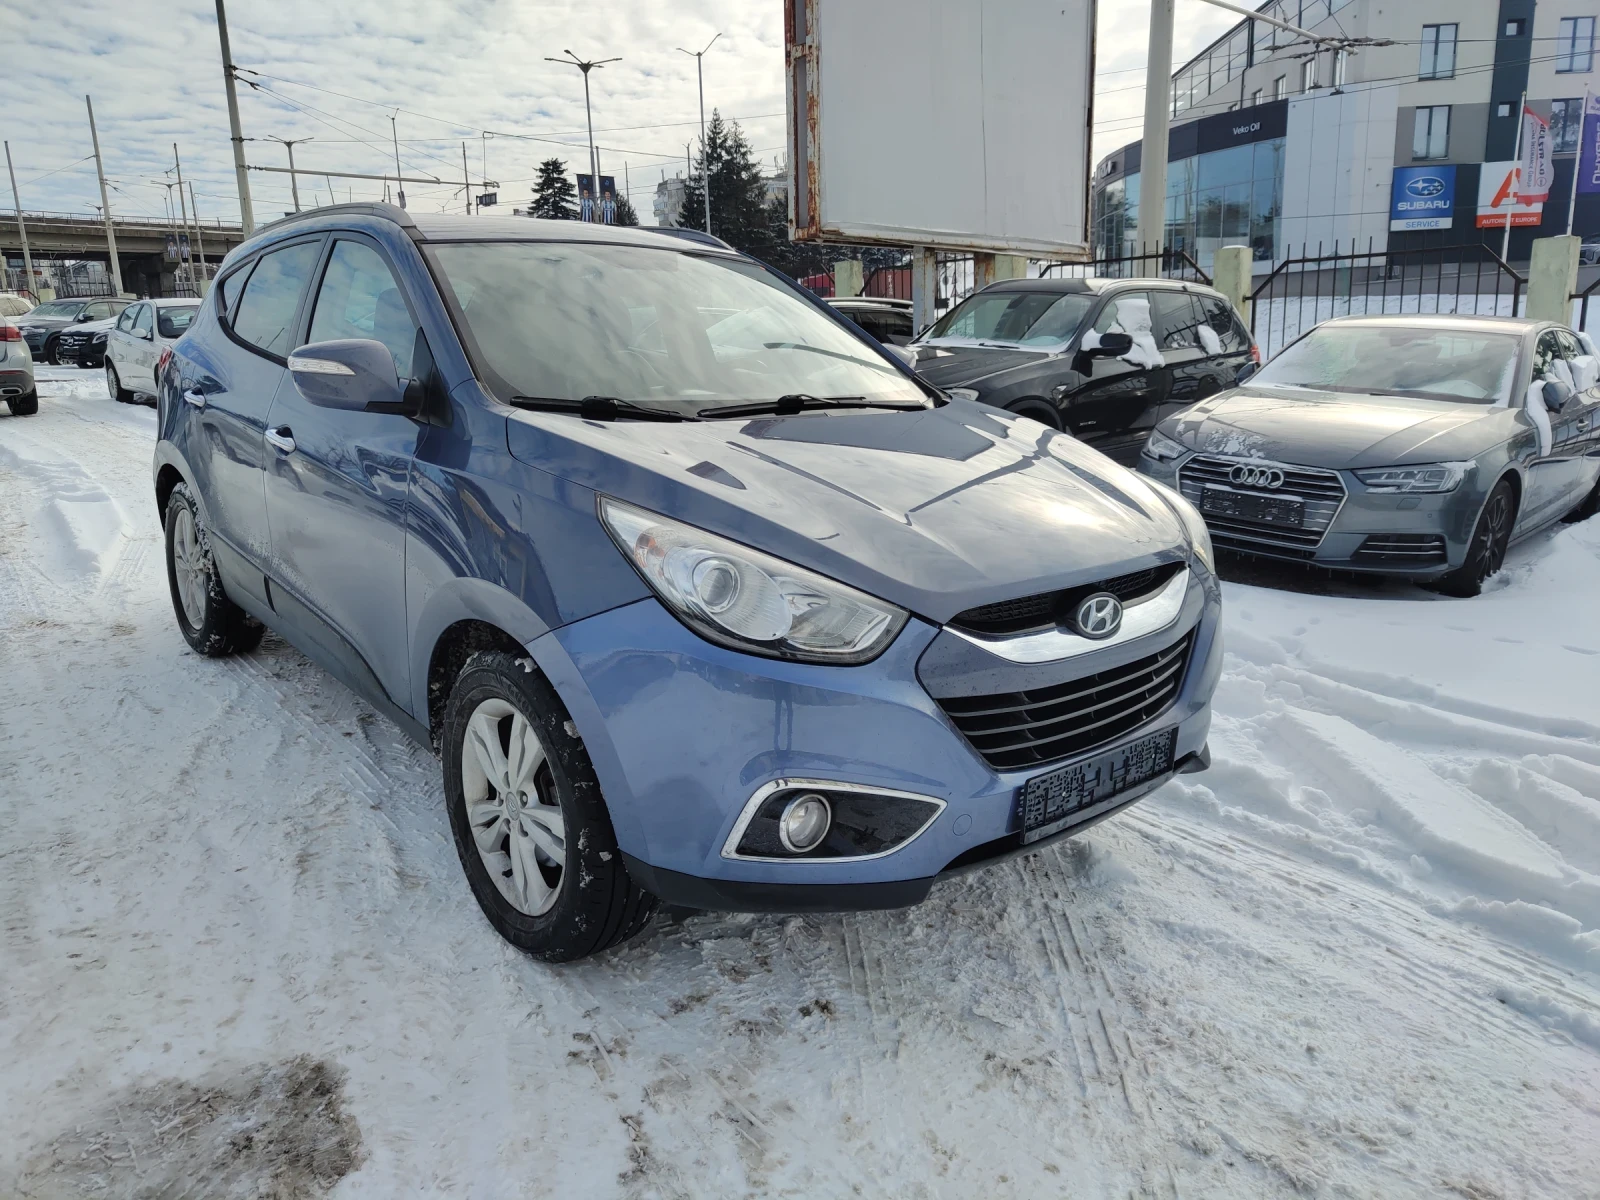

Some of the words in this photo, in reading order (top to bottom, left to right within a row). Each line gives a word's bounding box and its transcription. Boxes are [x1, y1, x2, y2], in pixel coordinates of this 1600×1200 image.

[1233, 126, 1249, 135] Veko
[1250, 121, 1261, 131] Oil
[1397, 200, 1450, 211] SUBARU
[1405, 220, 1440, 229] SERVICE
